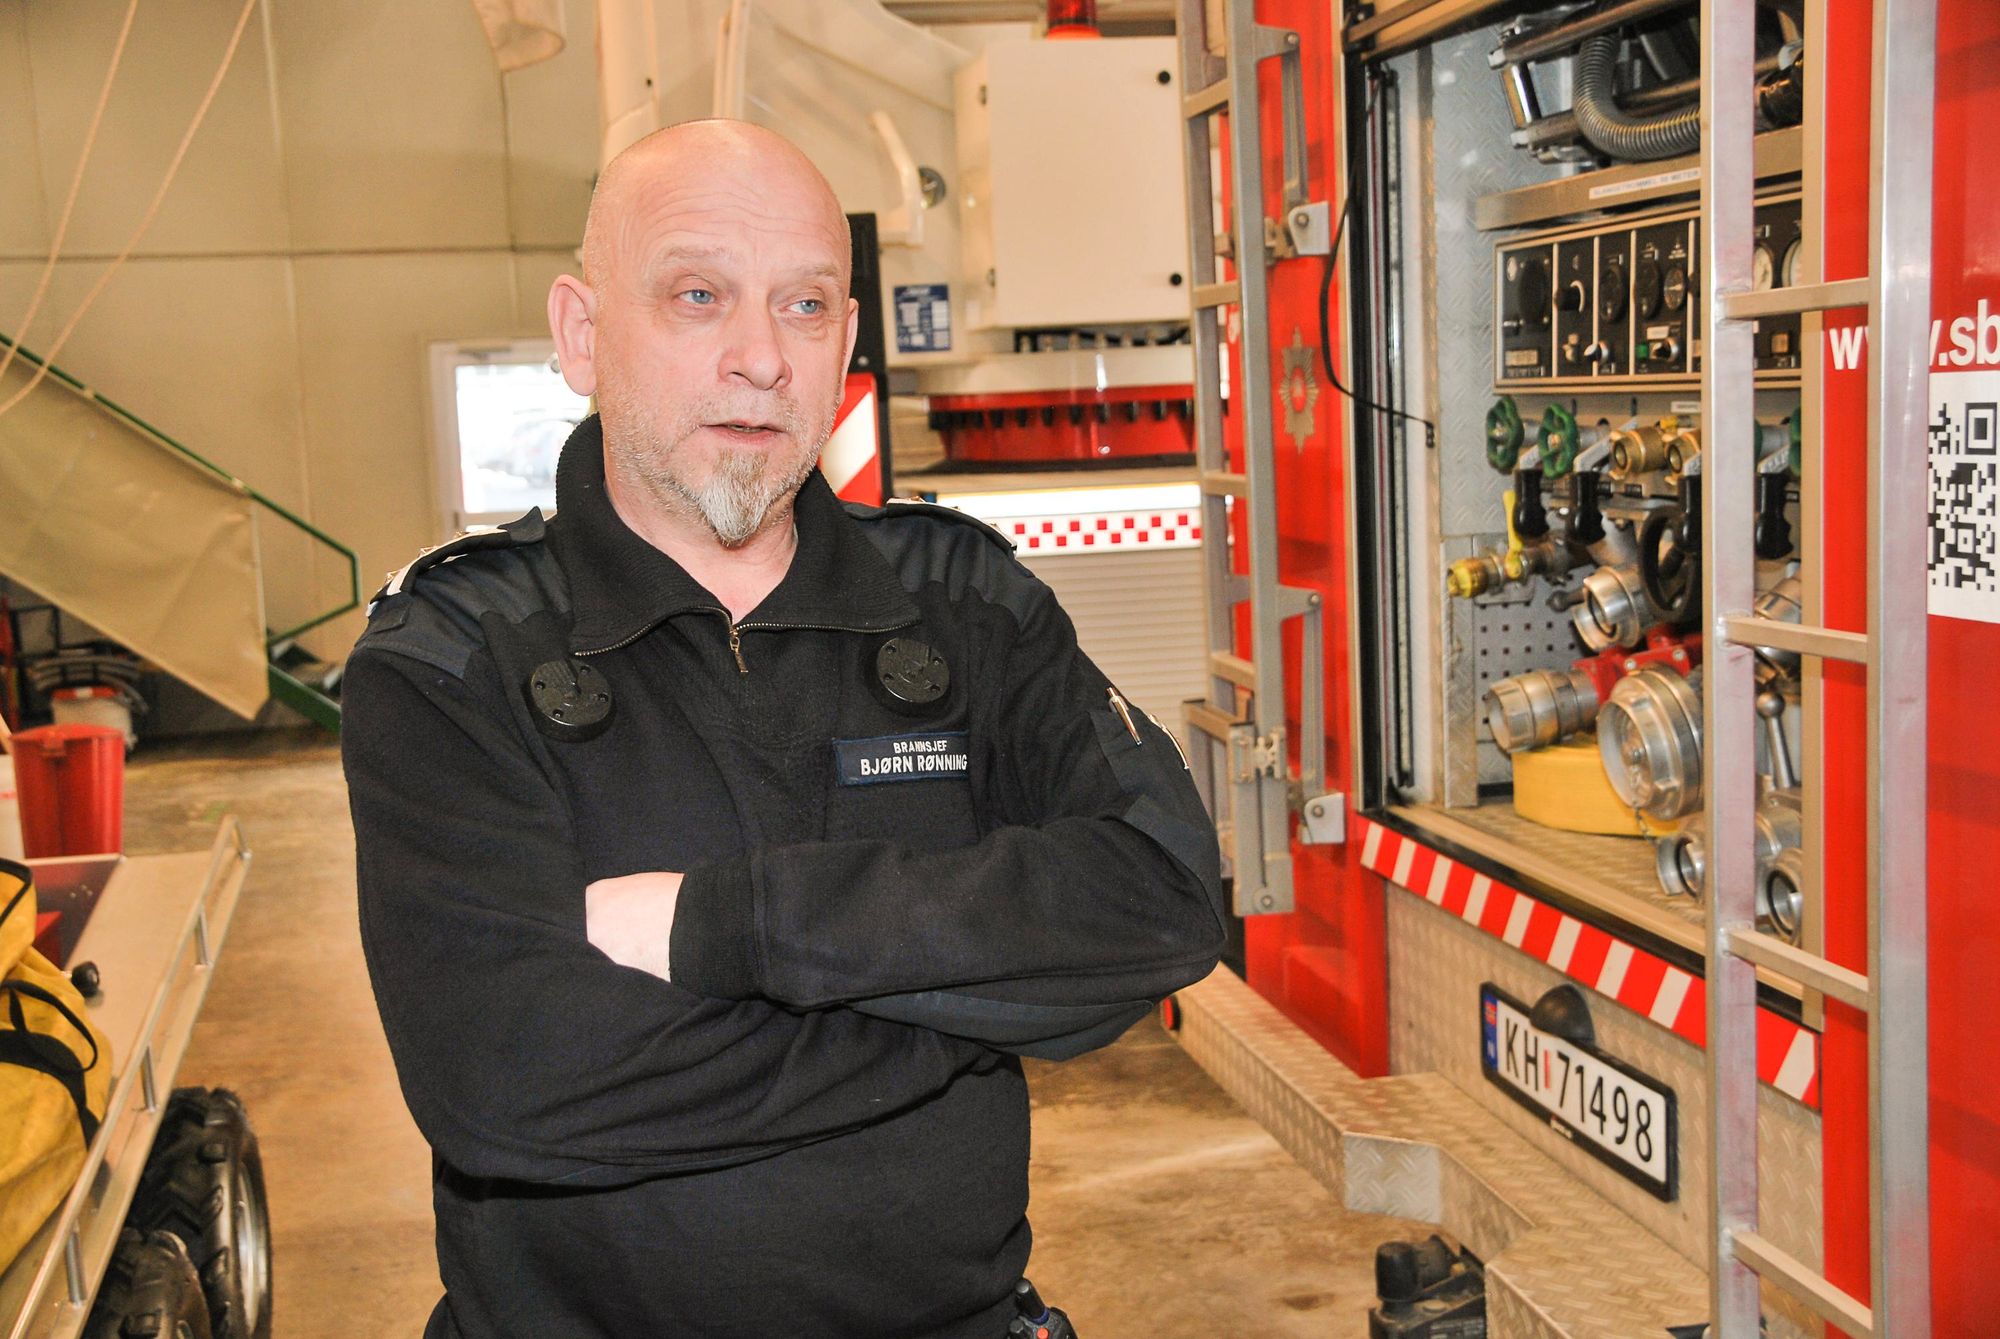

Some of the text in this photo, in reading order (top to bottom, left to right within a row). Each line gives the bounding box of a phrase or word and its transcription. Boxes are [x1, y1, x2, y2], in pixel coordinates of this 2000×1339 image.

[893, 740, 947, 753] BRANNSJEF
[860, 754, 968, 775] BJØRN RØNNING
[1506, 1017, 1653, 1163] KH 71498
